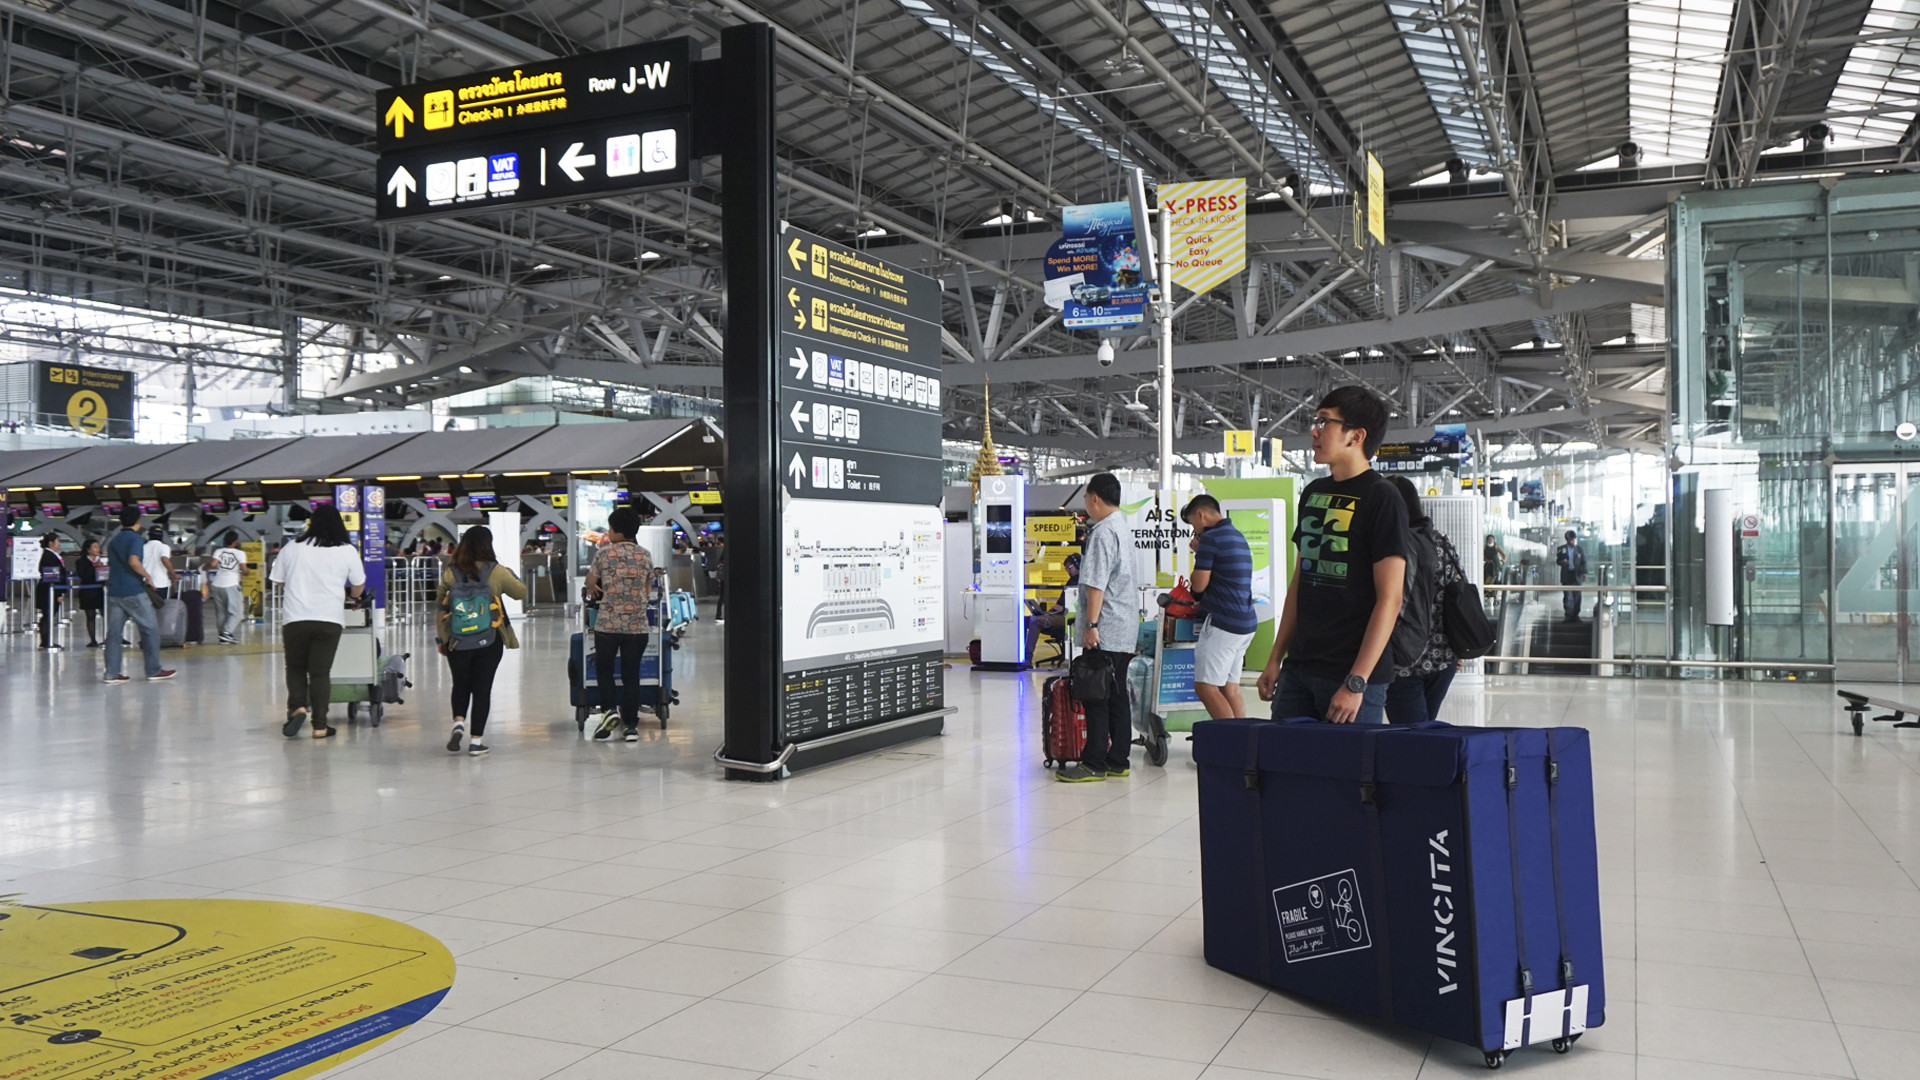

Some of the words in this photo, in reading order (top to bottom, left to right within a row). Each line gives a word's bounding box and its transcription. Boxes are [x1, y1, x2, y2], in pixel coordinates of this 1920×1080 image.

[588, 78, 616, 92] Row
[622, 61, 670, 94] J-W
[458, 106, 504, 125] Check-in
[492, 156, 516, 172] VAT
[1165, 195, 1237, 214] X-PRESS
[1211, 214, 1237, 224] KIOSK
[1185, 235, 1213, 245] Quick
[1189, 247, 1210, 256] Easy
[1048, 256, 1071, 265] Spend
[1073, 254, 1098, 263] MORE!
[1176, 260, 1189, 268] No
[1191, 258, 1223, 267] Queue
[1057, 265, 1071, 273] Win
[1073, 263, 1098, 271] MORE!
[850, 279, 871, 293] Check-in
[1072, 307, 1080, 317] 6
[1091, 305, 1104, 316] 10
[857, 331, 877, 344] Check-in
[830, 358, 843, 370] VAT
[82, 369, 124, 381] International
[81, 378, 120, 389] Departures
[79, 397, 97, 428] 2
[1232, 433, 1246, 452] L
[1145, 509, 1175, 522] AIS
[1033, 523, 1060, 533] SPEED
[1060, 523, 1072, 533] UP
[1281, 906, 1308, 925] FRAGILE
[1429, 829, 1458, 995] VINCITA
[1288, 940, 1309, 955] Thank
[62, 990, 148, 1017] check-in
[146, 982, 175, 990] at
[174, 965, 234, 984] normal
[234, 946, 296, 964] counter
[43, 1000, 92, 1014] Early
[91, 986, 140, 999] bird
[230, 1008, 298, 1031] X-Press
[300, 983, 372, 1008] check-in
